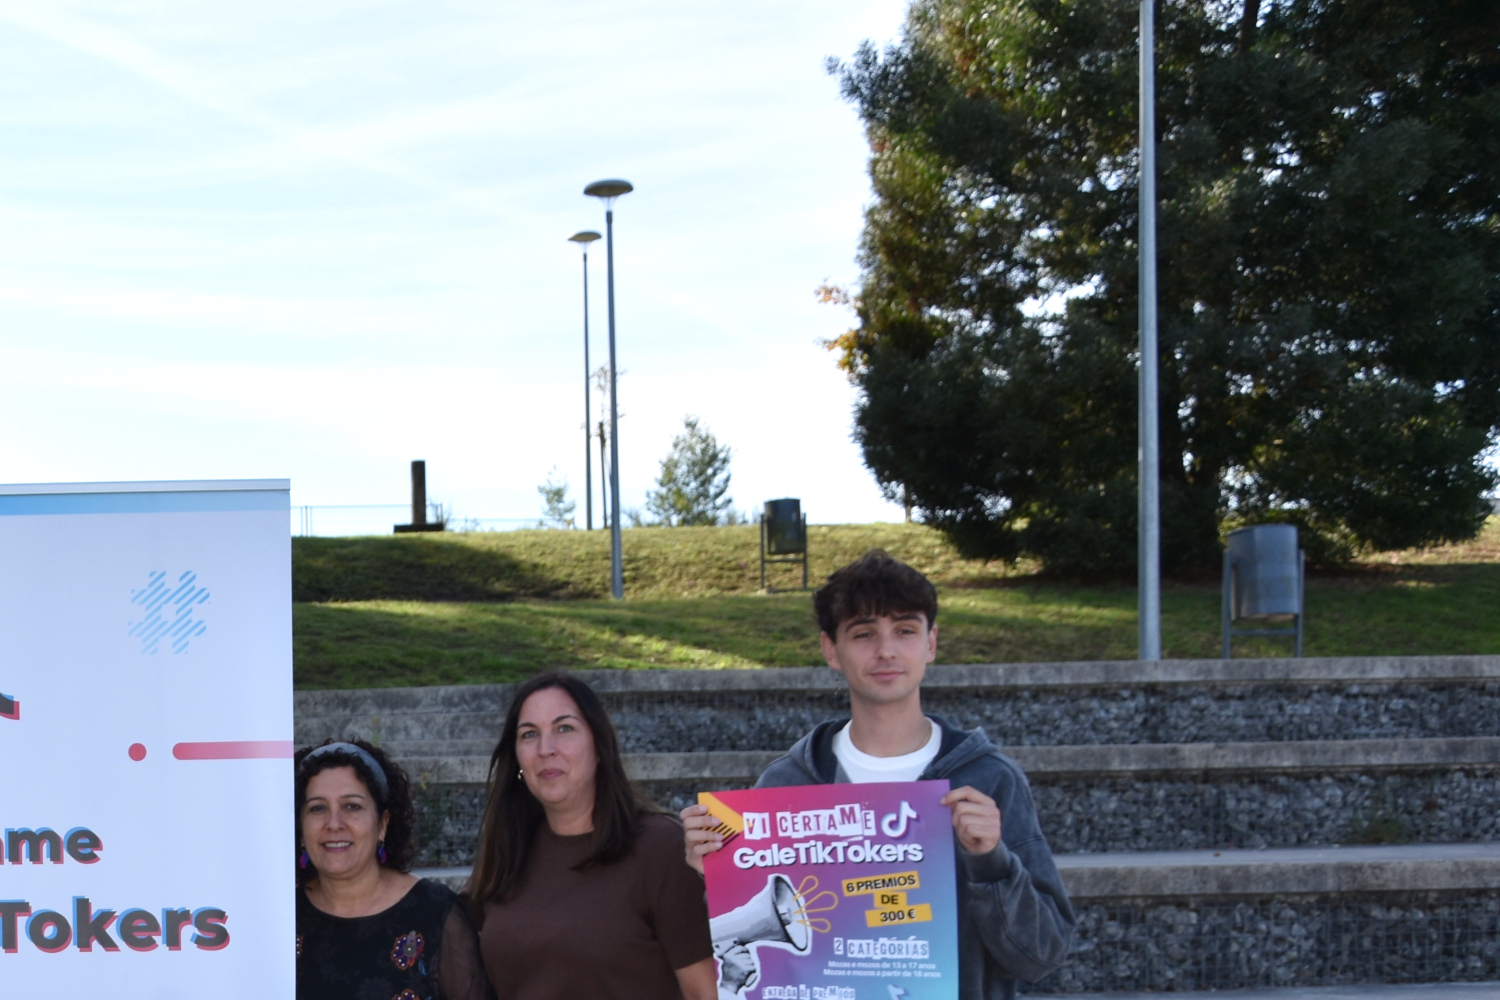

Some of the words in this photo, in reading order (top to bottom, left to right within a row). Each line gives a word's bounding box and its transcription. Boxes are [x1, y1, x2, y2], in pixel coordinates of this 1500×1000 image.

[746, 816, 768, 835] VI
[779, 805, 873, 834] CERTAME
[733, 840, 923, 868] GaleTikTokers
[847, 883, 855, 893] 6
[857, 875, 915, 891] PREMIOS
[881, 895, 898, 905] DE
[880, 910, 905, 922] 300
[907, 910, 915, 919] €
[835, 939, 842, 952] 2
